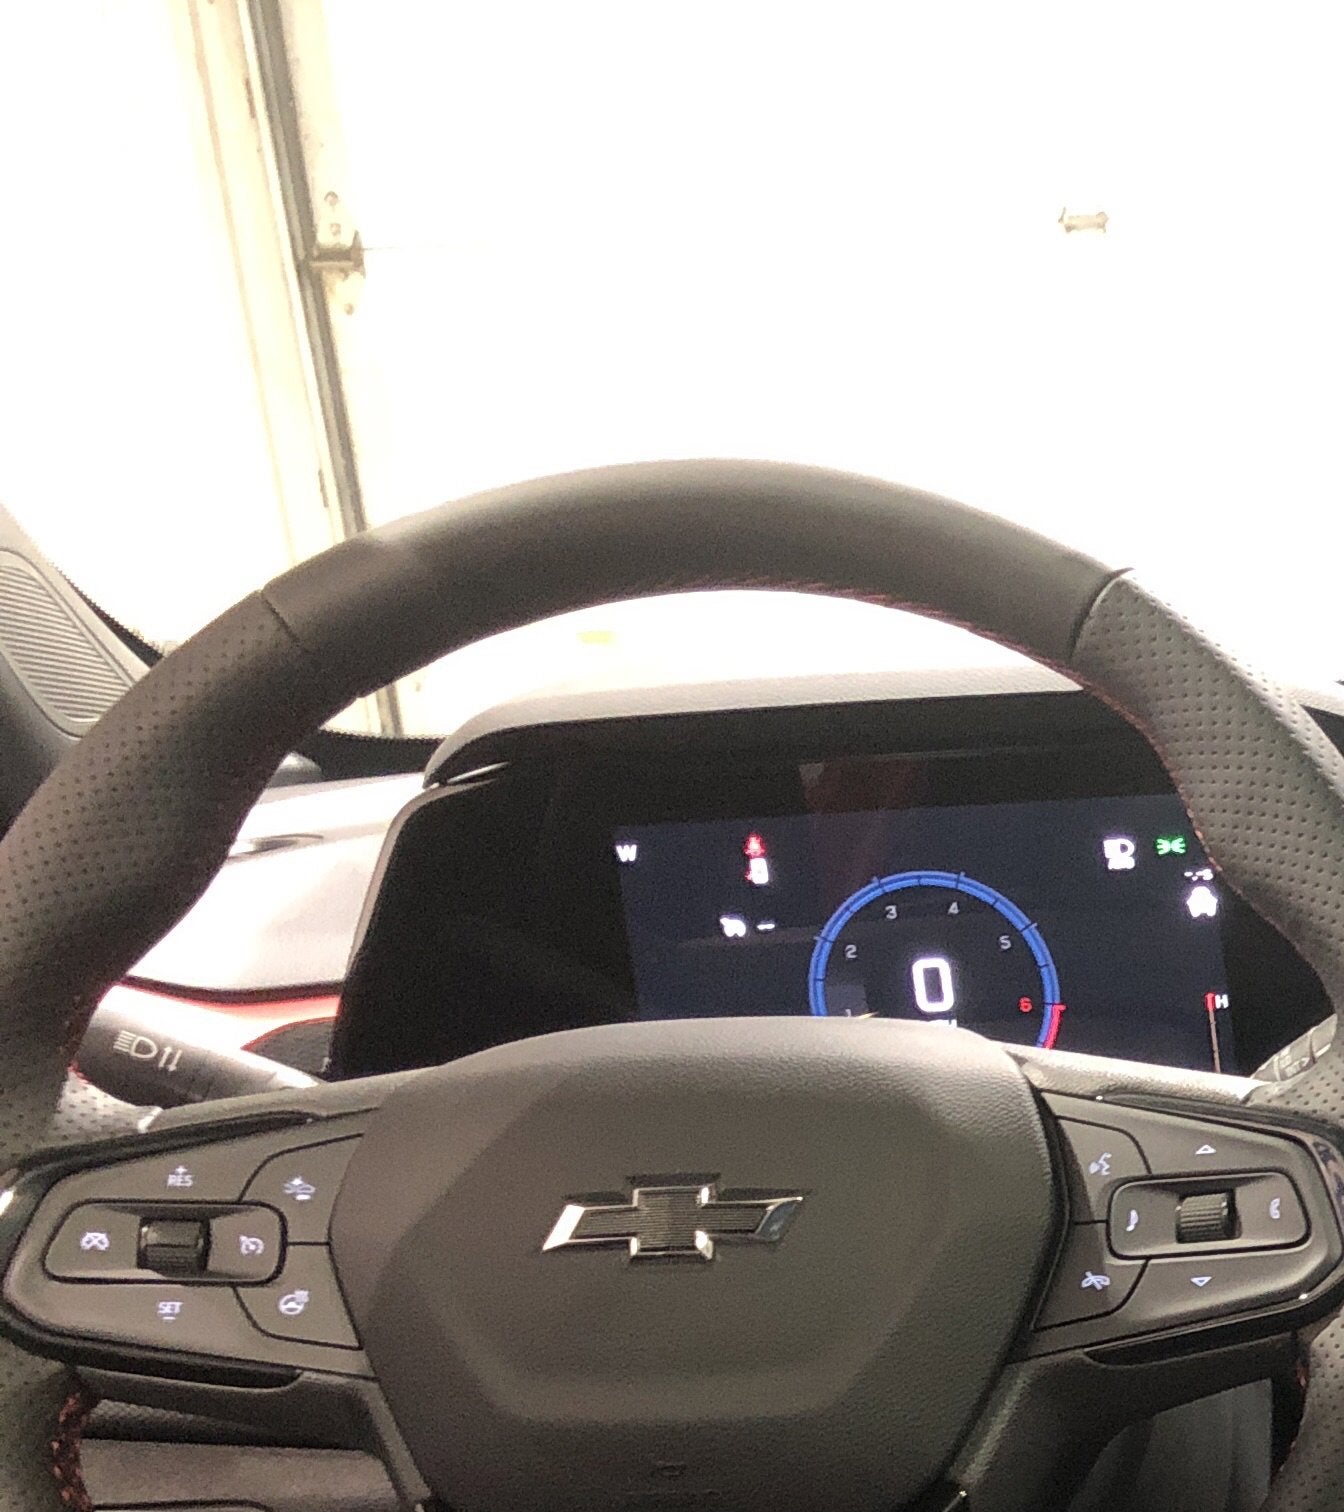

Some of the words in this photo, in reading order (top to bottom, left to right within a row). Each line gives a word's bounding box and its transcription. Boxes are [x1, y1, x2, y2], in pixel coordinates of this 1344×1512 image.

[615, 844, 638, 862] W
[885, 905, 897, 919] 3
[948, 901, 959, 915] 4
[999, 935, 1012, 950] 5
[845, 945, 858, 959] 2
[912, 957, 954, 1013] 0
[1215, 994, 1229, 1009] H
[167, 1174, 193, 1188] RES
[158, 1301, 183, 1314] SET
